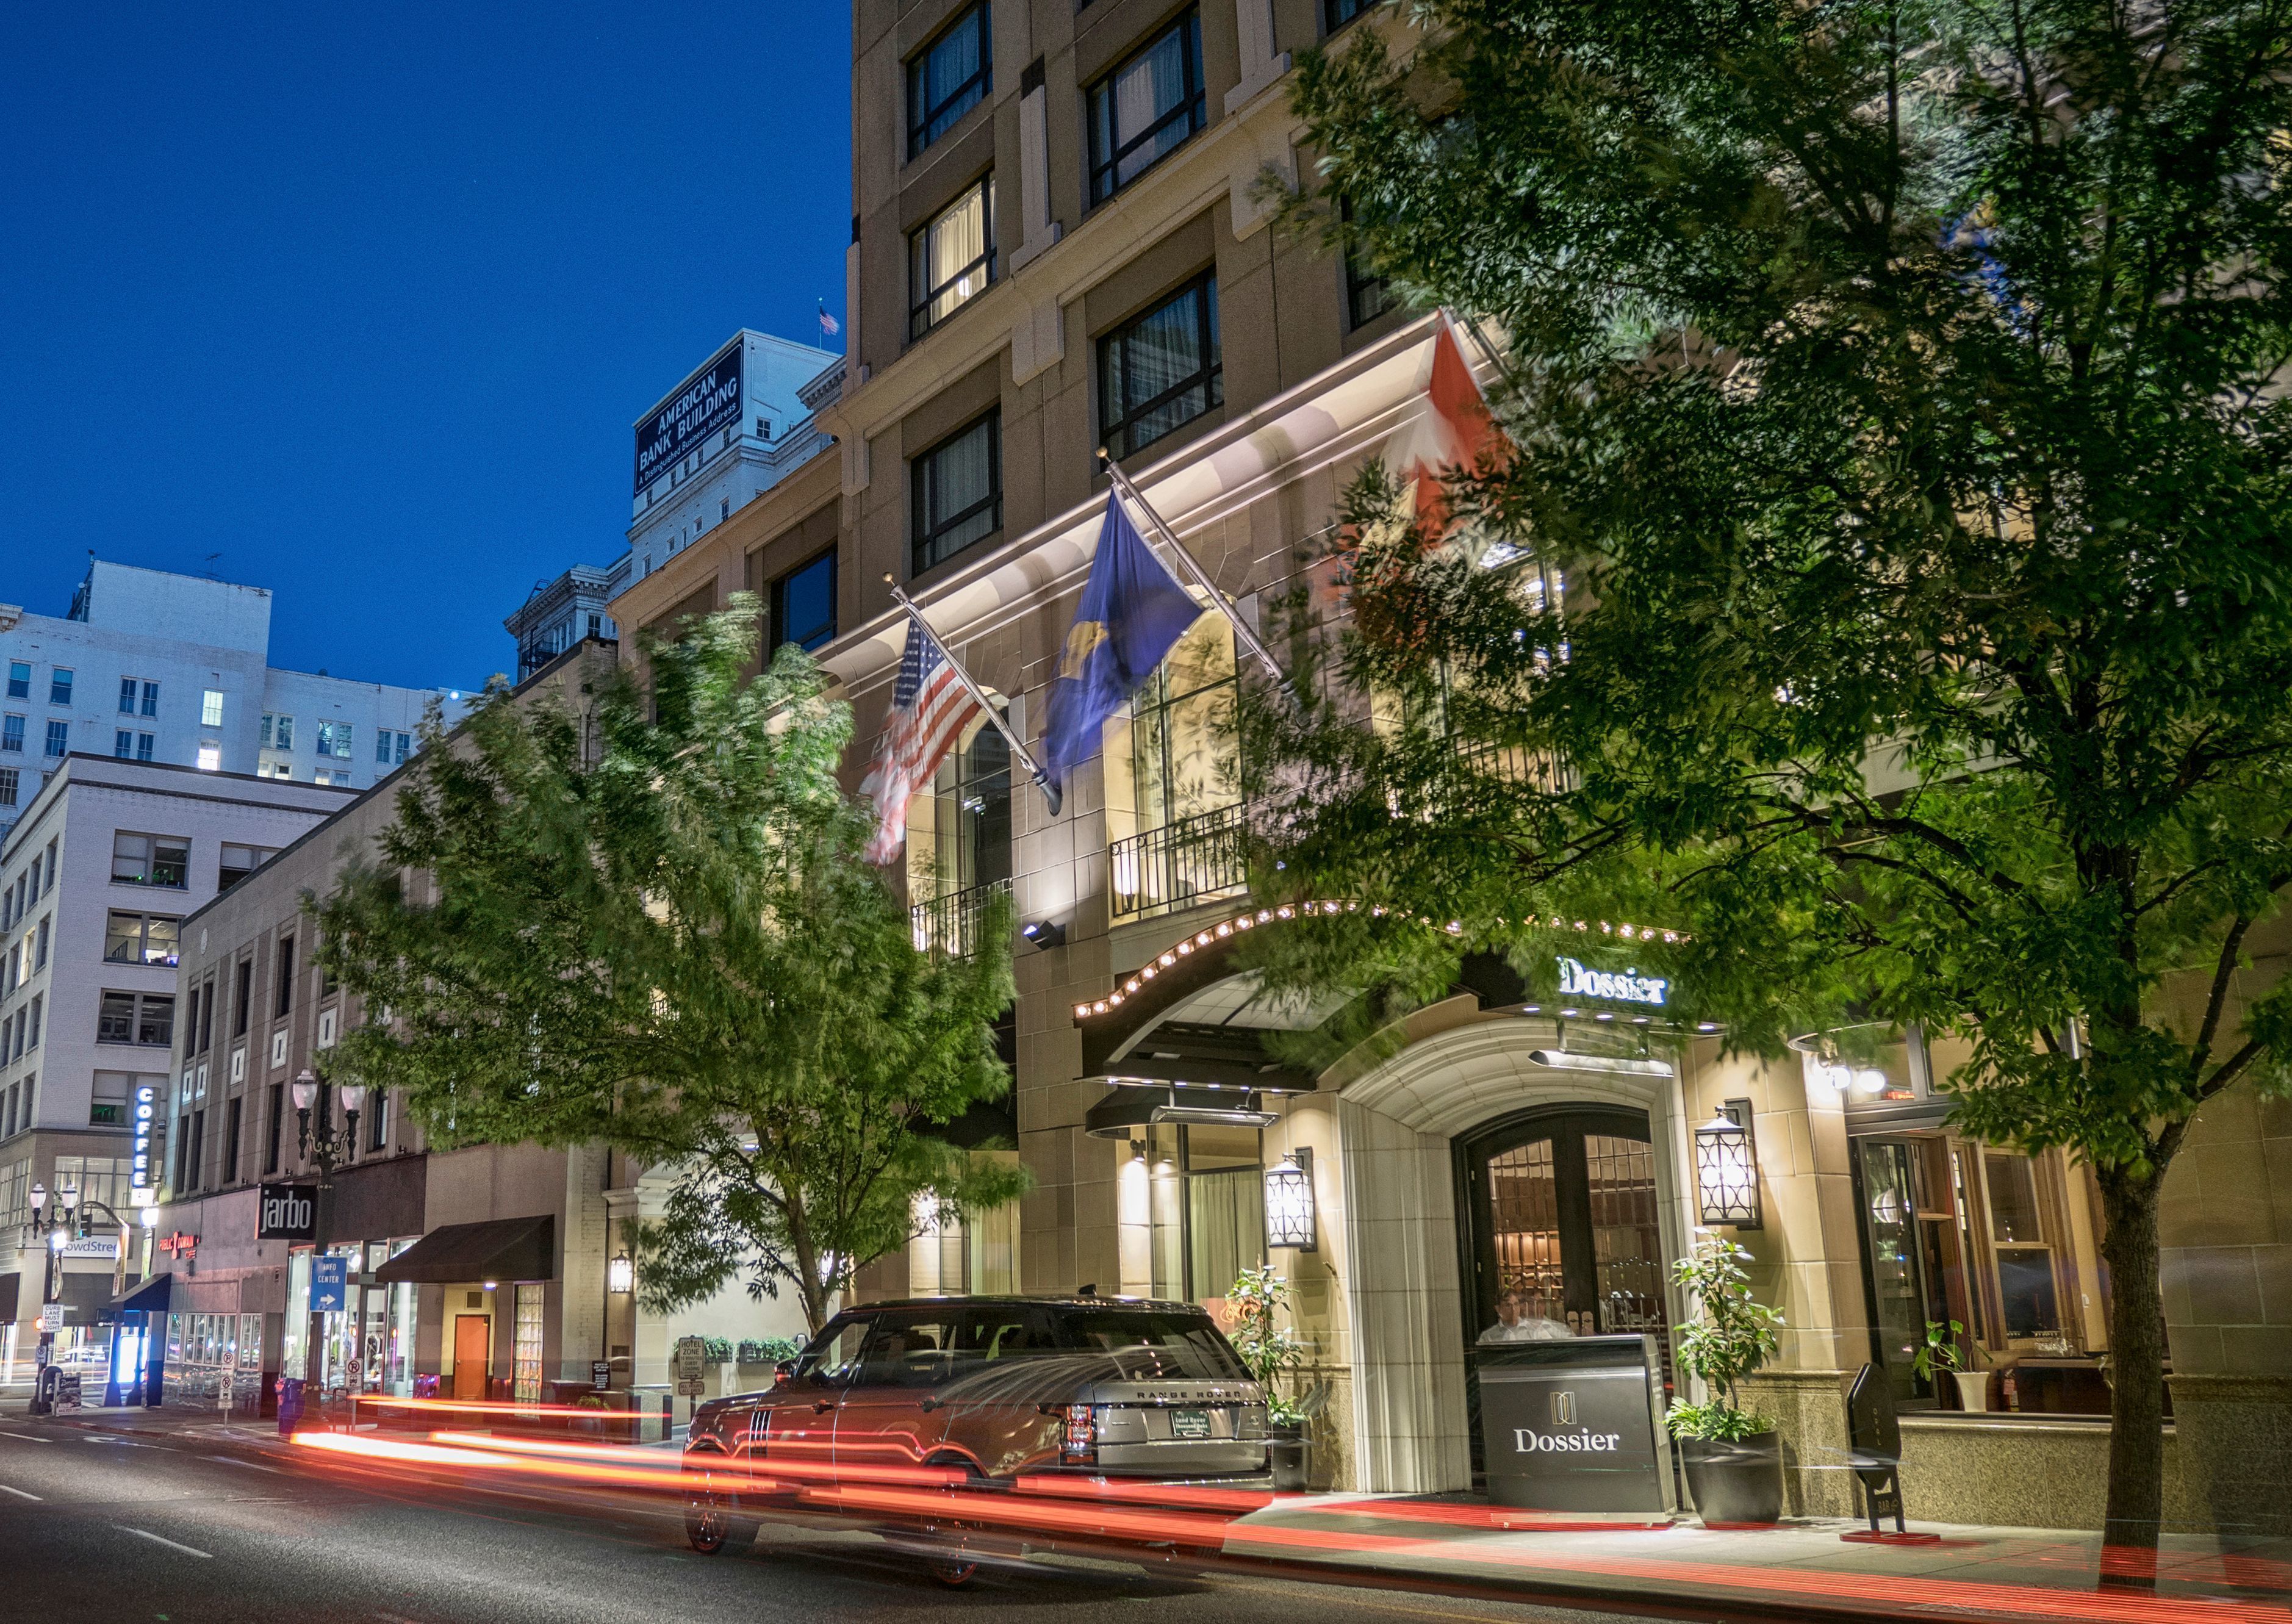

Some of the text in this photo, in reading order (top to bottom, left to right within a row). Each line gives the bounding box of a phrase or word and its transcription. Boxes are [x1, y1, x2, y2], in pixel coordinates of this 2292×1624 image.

[640, 377, 737, 472] BANK BUILDING
[658, 371, 716, 435] AMERICAN
[639, 403, 736, 486] A Distinguished Business Address
[1555, 956, 1666, 1004] Dossier
[133, 1087, 153, 1187] COFFEE
[260, 1190, 311, 1232] jarbo
[1513, 1427, 1620, 1453] Dossier
[1878, 1500, 1890, 1514] BAR
